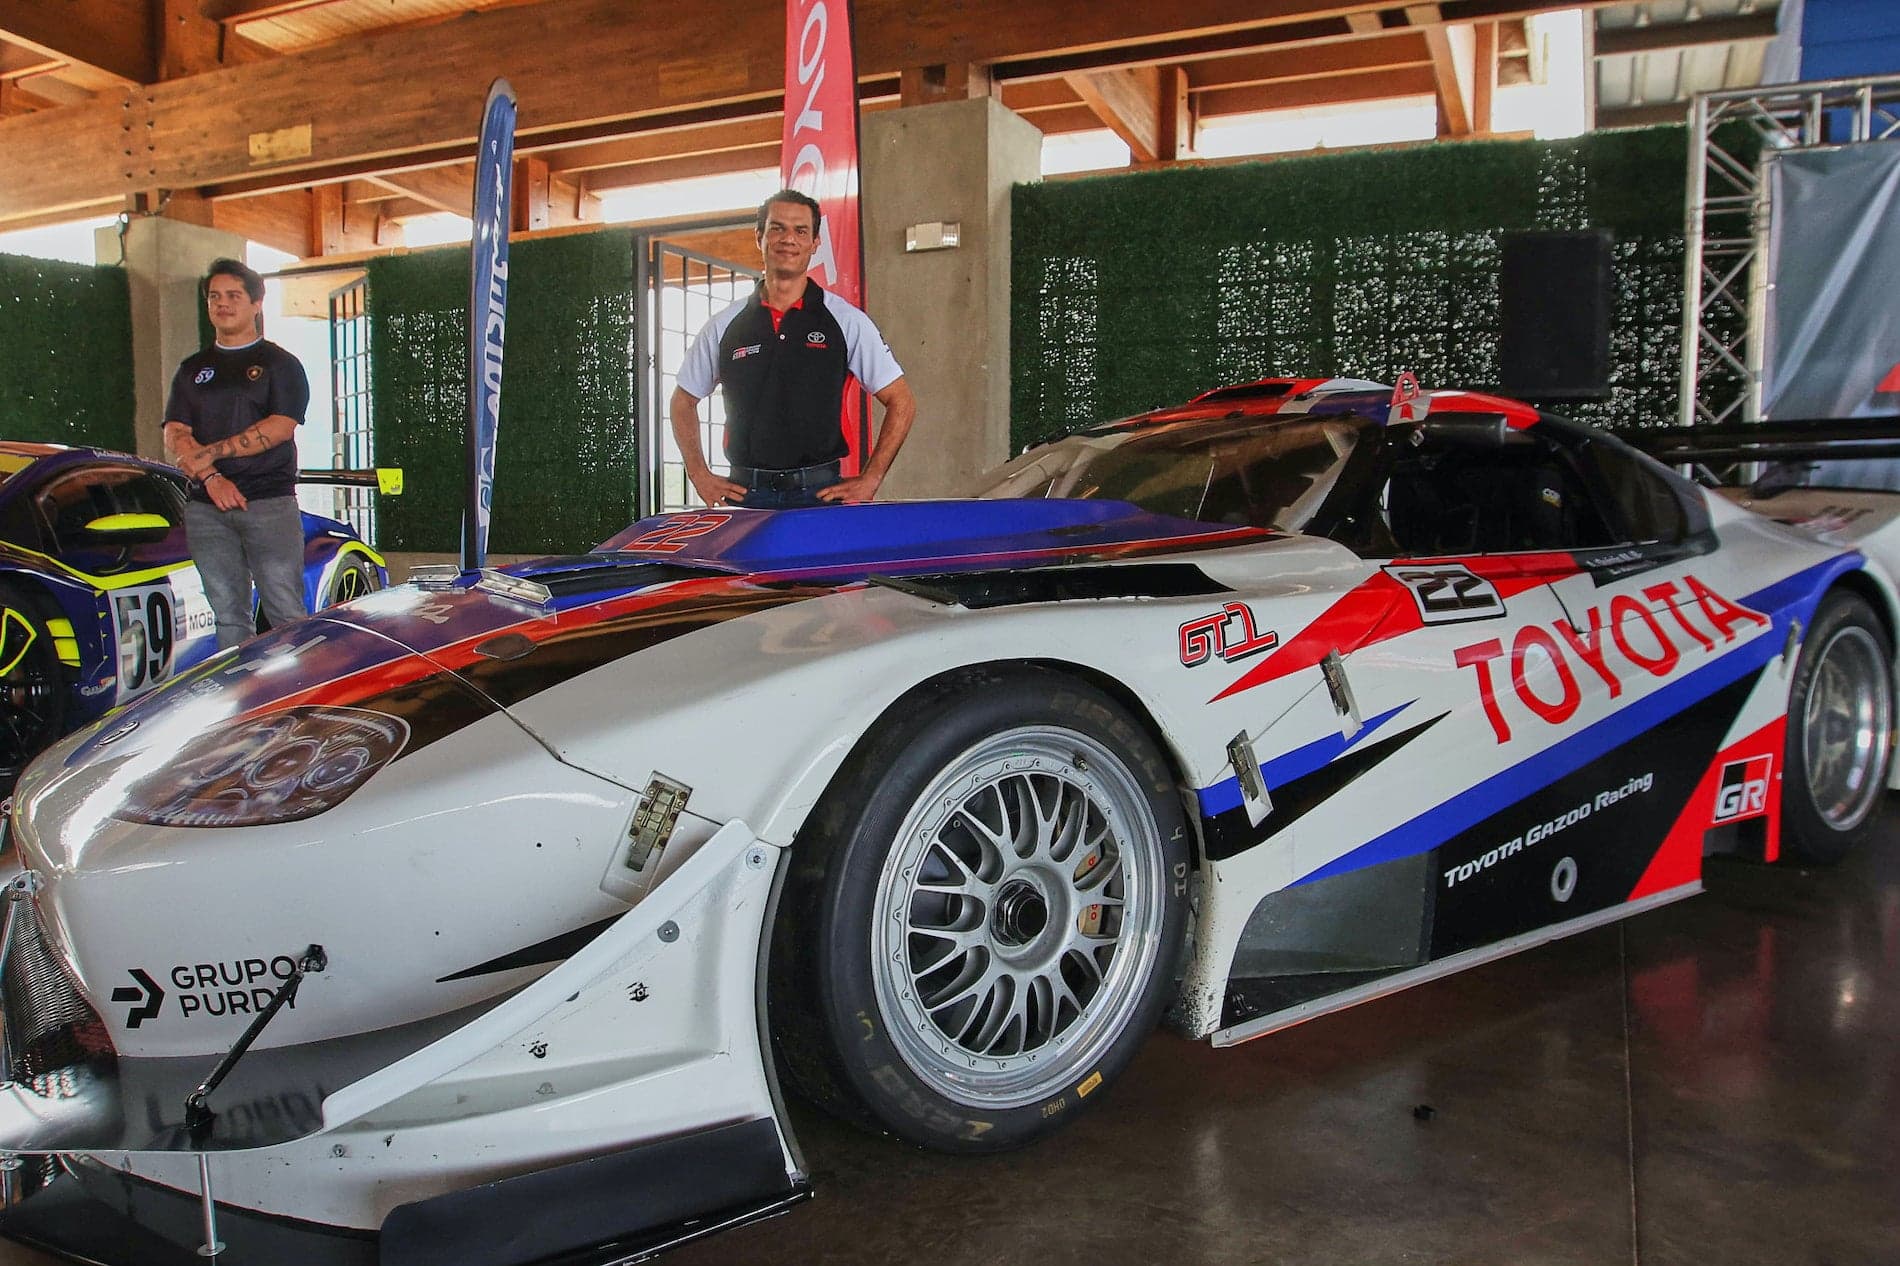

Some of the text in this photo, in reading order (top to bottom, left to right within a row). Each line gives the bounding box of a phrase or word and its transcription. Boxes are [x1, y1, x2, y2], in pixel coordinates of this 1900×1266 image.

[194, 367, 215, 384] 59
[617, 513, 733, 554] 22
[1398, 570, 1498, 613] 22
[115, 591, 173, 690] 59
[188, 612, 215, 631] MOB
[1178, 601, 1279, 668] GT1
[1453, 575, 1771, 745] TOYOTA
[1715, 779, 1766, 819] GR
[1444, 772, 1654, 888] TOYOTA GAZOO Racing
[171, 955, 297, 989] GRUPO
